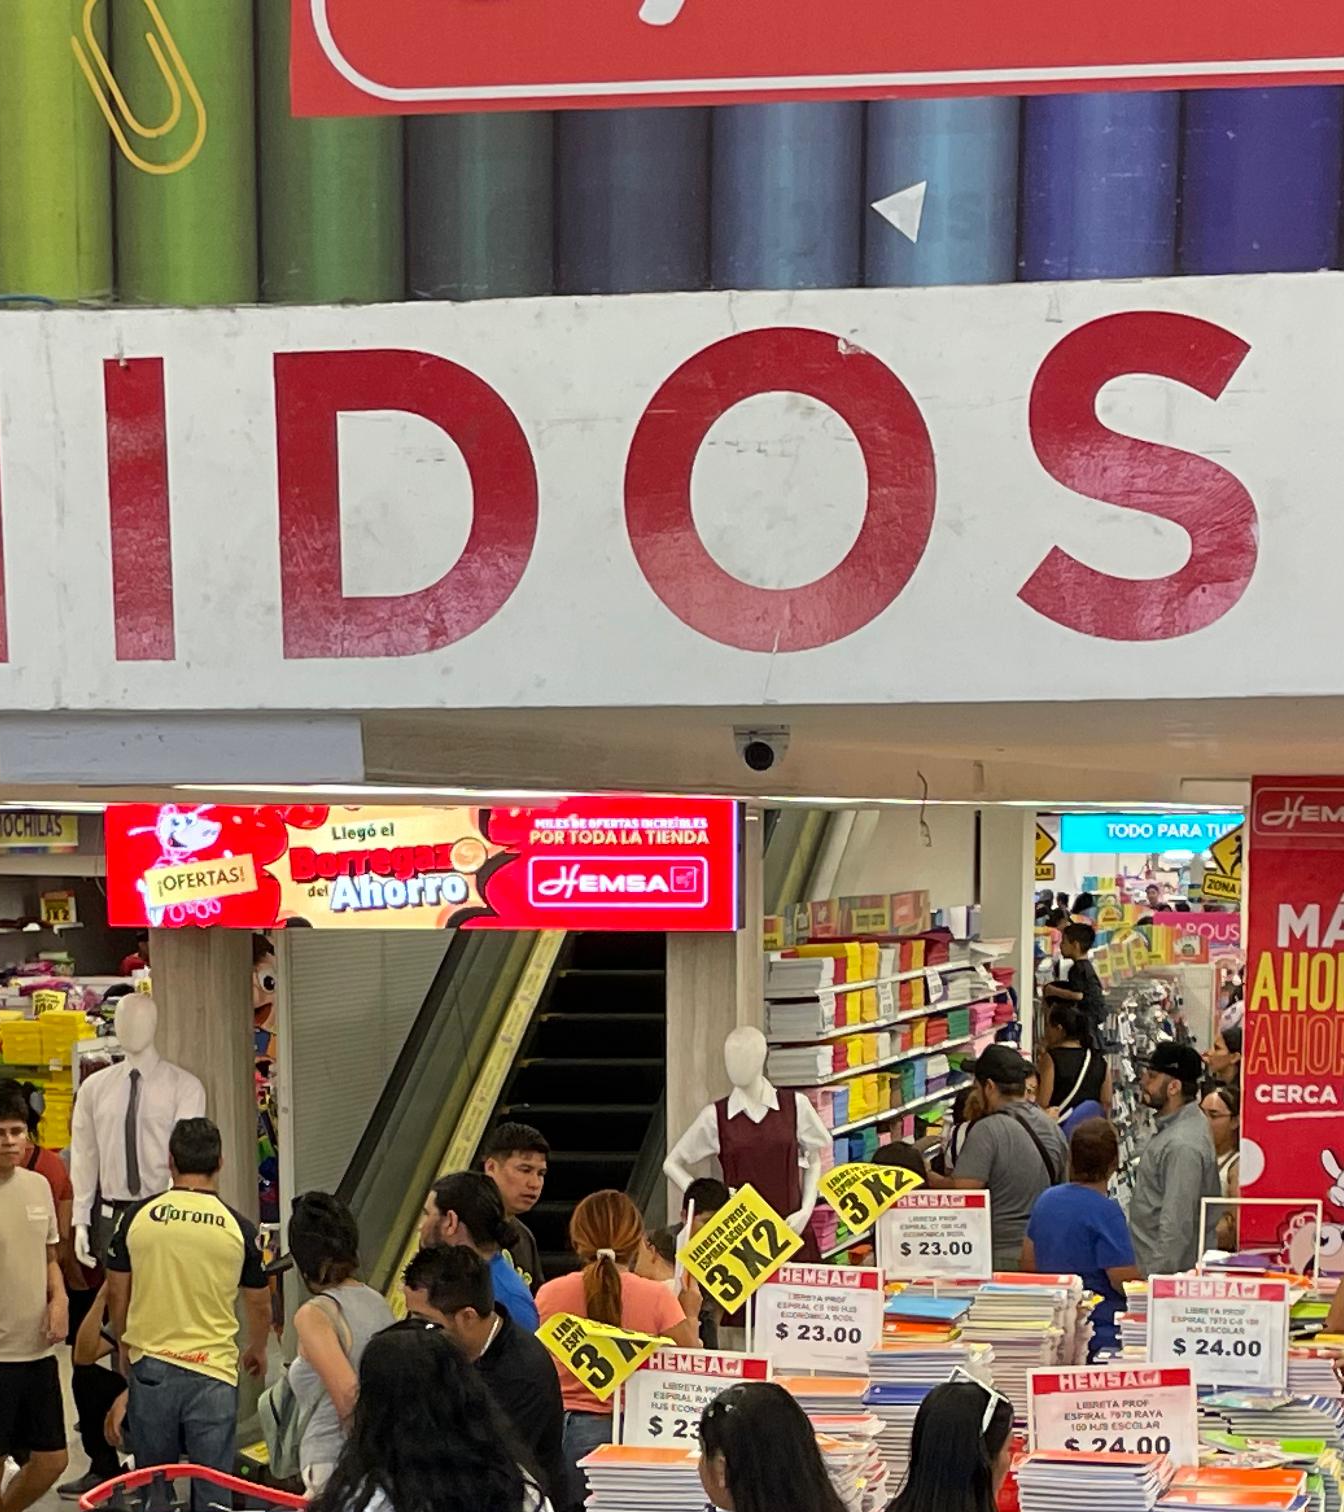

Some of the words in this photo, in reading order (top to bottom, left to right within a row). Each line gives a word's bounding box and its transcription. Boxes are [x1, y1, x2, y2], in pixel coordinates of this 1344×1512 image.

[332, 825, 376, 842] Llegó
[380, 823, 394, 838] el
[589, 818, 639, 829] OFERTAS
[1107, 823, 1153, 839] TODO
[1157, 823, 1203, 839] PARA
[529, 830, 566, 845] POR
[568, 830, 618, 845] TODA
[621, 830, 643, 845] LA
[645, 830, 710, 845] TIENDA
[157, 866, 245, 897] ¡OFERTAS!
[538, 864, 670, 898] HEMSA
[1207, 878, 1236, 894] ZONA
[308, 884, 328, 898] del
[330, 872, 469, 913] Ahorro
[1255, 1084, 1333, 1104] CERCA
[149, 1203, 227, 1229] Corona
[900, 1242, 912, 1257] $
[919, 1241, 973, 1256] 23.00
[779, 1267, 842, 1285] HEMSA
[1175, 1280, 1242, 1299] HEMSA
[776, 1322, 788, 1340] $
[797, 1325, 862, 1344] 23.00
[1173, 1338, 1186, 1356] $
[1196, 1339, 1261, 1357] 24.00
[649, 1352, 721, 1374] HEMSA
[1059, 1370, 1137, 1391] HEMSA
[1076, 1401, 1119, 1410] LIBRETA
[1122, 1400, 1150, 1408] PROF
[1064, 1412, 1106, 1421] ESPIRAL
[1135, 1410, 1163, 1418] RAYA
[648, 1415, 663, 1438] $
[1112, 1422, 1160, 1430] ESCOLAR
[1064, 1438, 1080, 1452] $
[1091, 1436, 1171, 1455] 24.00
